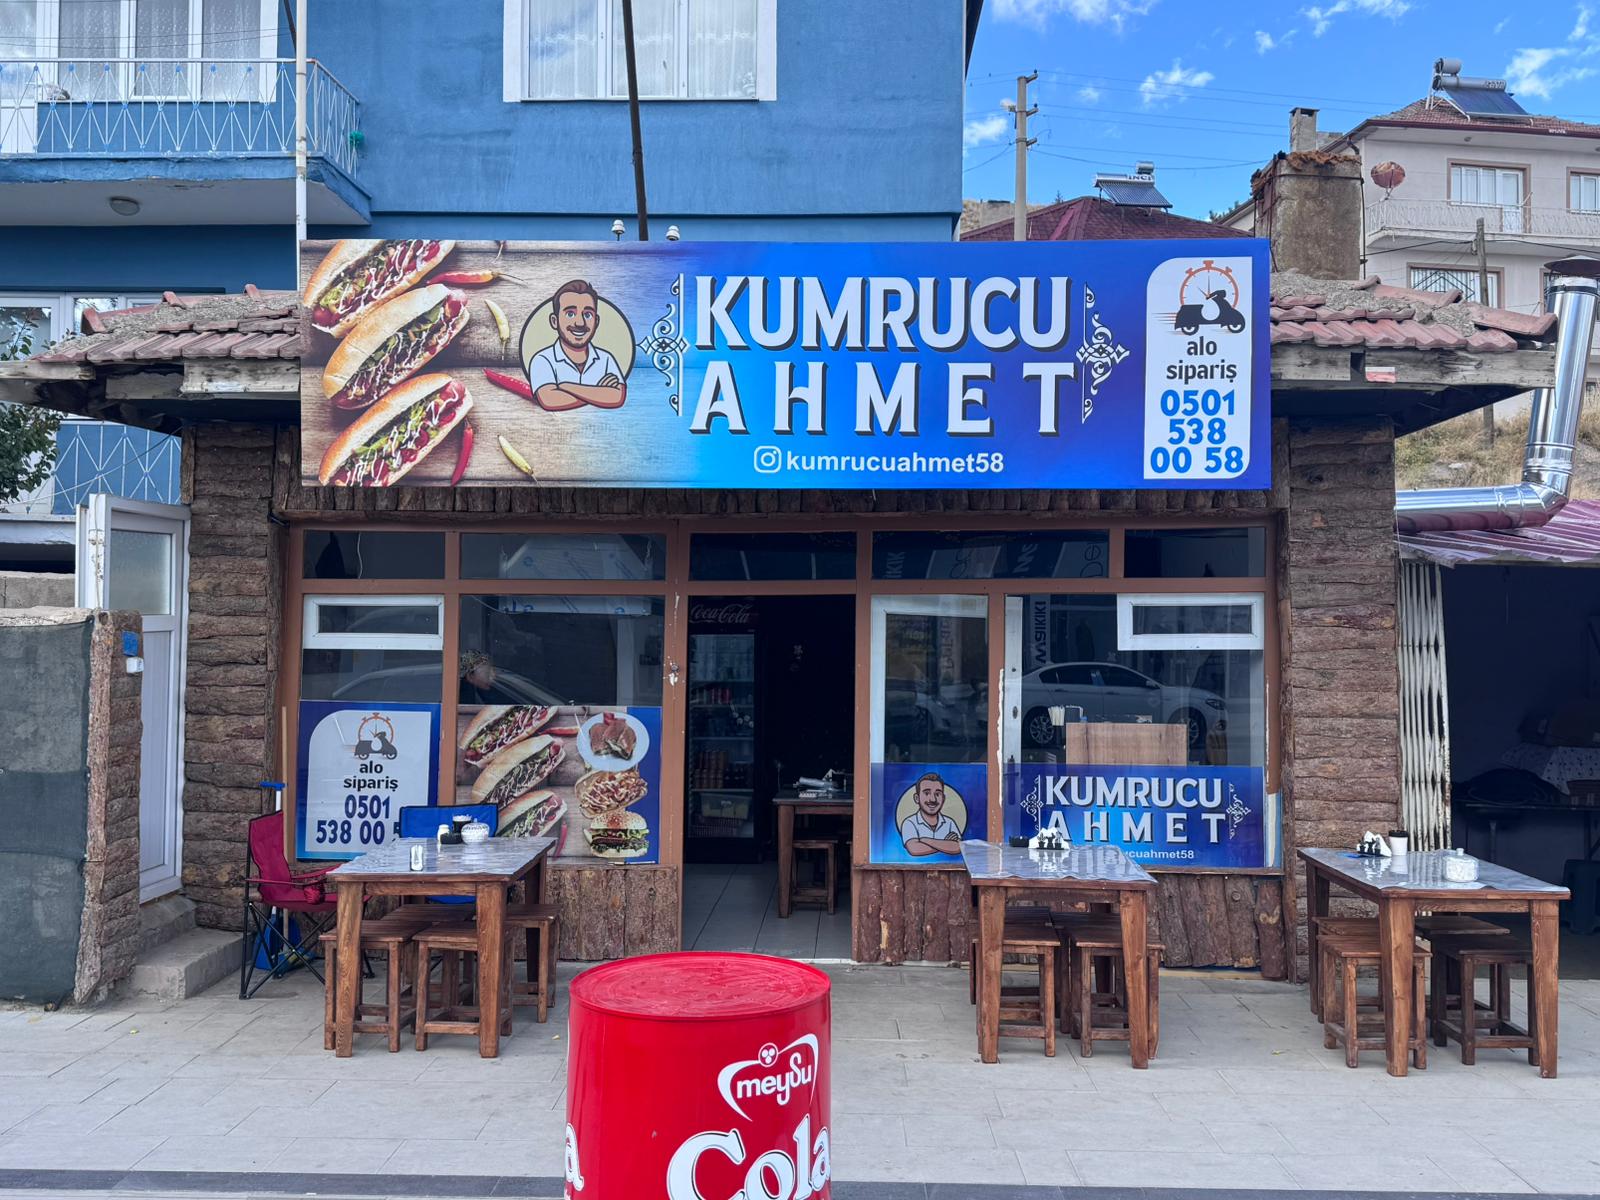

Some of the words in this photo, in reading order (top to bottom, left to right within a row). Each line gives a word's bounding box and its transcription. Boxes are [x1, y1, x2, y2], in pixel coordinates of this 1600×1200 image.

[695, 276, 1071, 351] KUMRUCU
[1187, 336, 1217, 355] alo
[1166, 359, 1237, 384] sipariş
[690, 361, 1077, 437] AHMET
[1160, 389, 1235, 416] 0501
[1168, 417, 1226, 445] 538
[787, 450, 1004, 473] kumrucuahmet58
[1150, 446, 1192, 473] 00
[1204, 446, 1243, 473] 58
[689, 603, 752, 624] Coca-Cola
[359, 761, 383, 774] alo
[343, 776, 399, 792] sipariş
[1045, 775, 1222, 808] KUMRUCU
[344, 794, 391, 819] 0501
[316, 819, 352, 844] 538
[360, 820, 385, 845] 00
[666, 1113, 830, 1200] Cola
